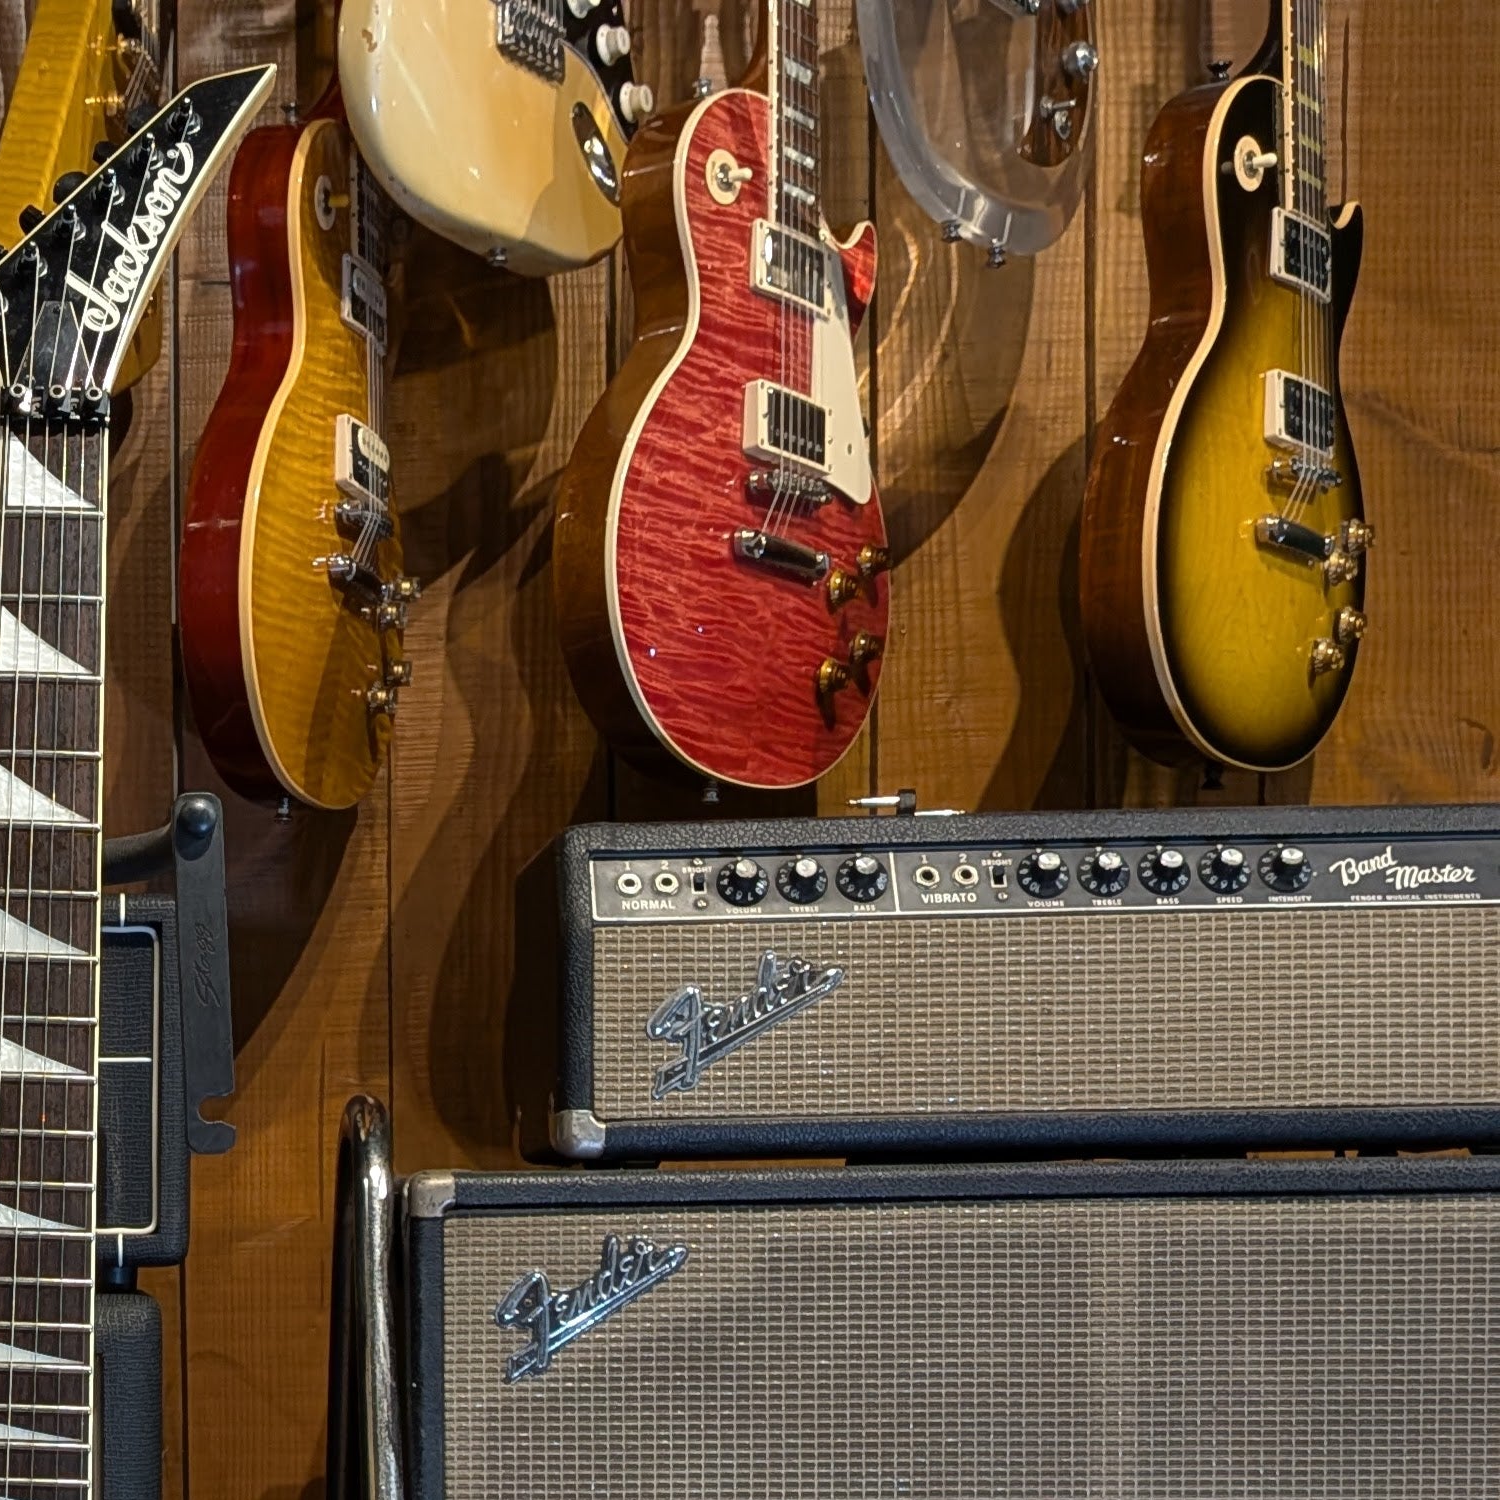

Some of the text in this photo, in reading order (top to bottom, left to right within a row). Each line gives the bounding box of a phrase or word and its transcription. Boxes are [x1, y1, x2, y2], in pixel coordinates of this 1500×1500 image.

[65, 142, 194, 332] Jackson
[959, 854, 967, 863] 2
[661, 861, 669, 870] 2
[1329, 845, 1477, 890] Band Master
[920, 892, 977, 904] VIBRATO
[1156, 897, 1180, 905] BASS
[1216, 896, 1243, 904] SPEED
[1268, 895, 1312, 903] INTENSITY
[621, 900, 676, 911] NORMAL
[853, 904, 877, 912] BASS
[1027, 900, 1065, 908] VOLUME
[725, 907, 762, 915] VOLUME
[191, 921, 222, 1008] Stagg
[646, 949, 845, 1099] Fender
[493, 1232, 690, 1384] Fender
